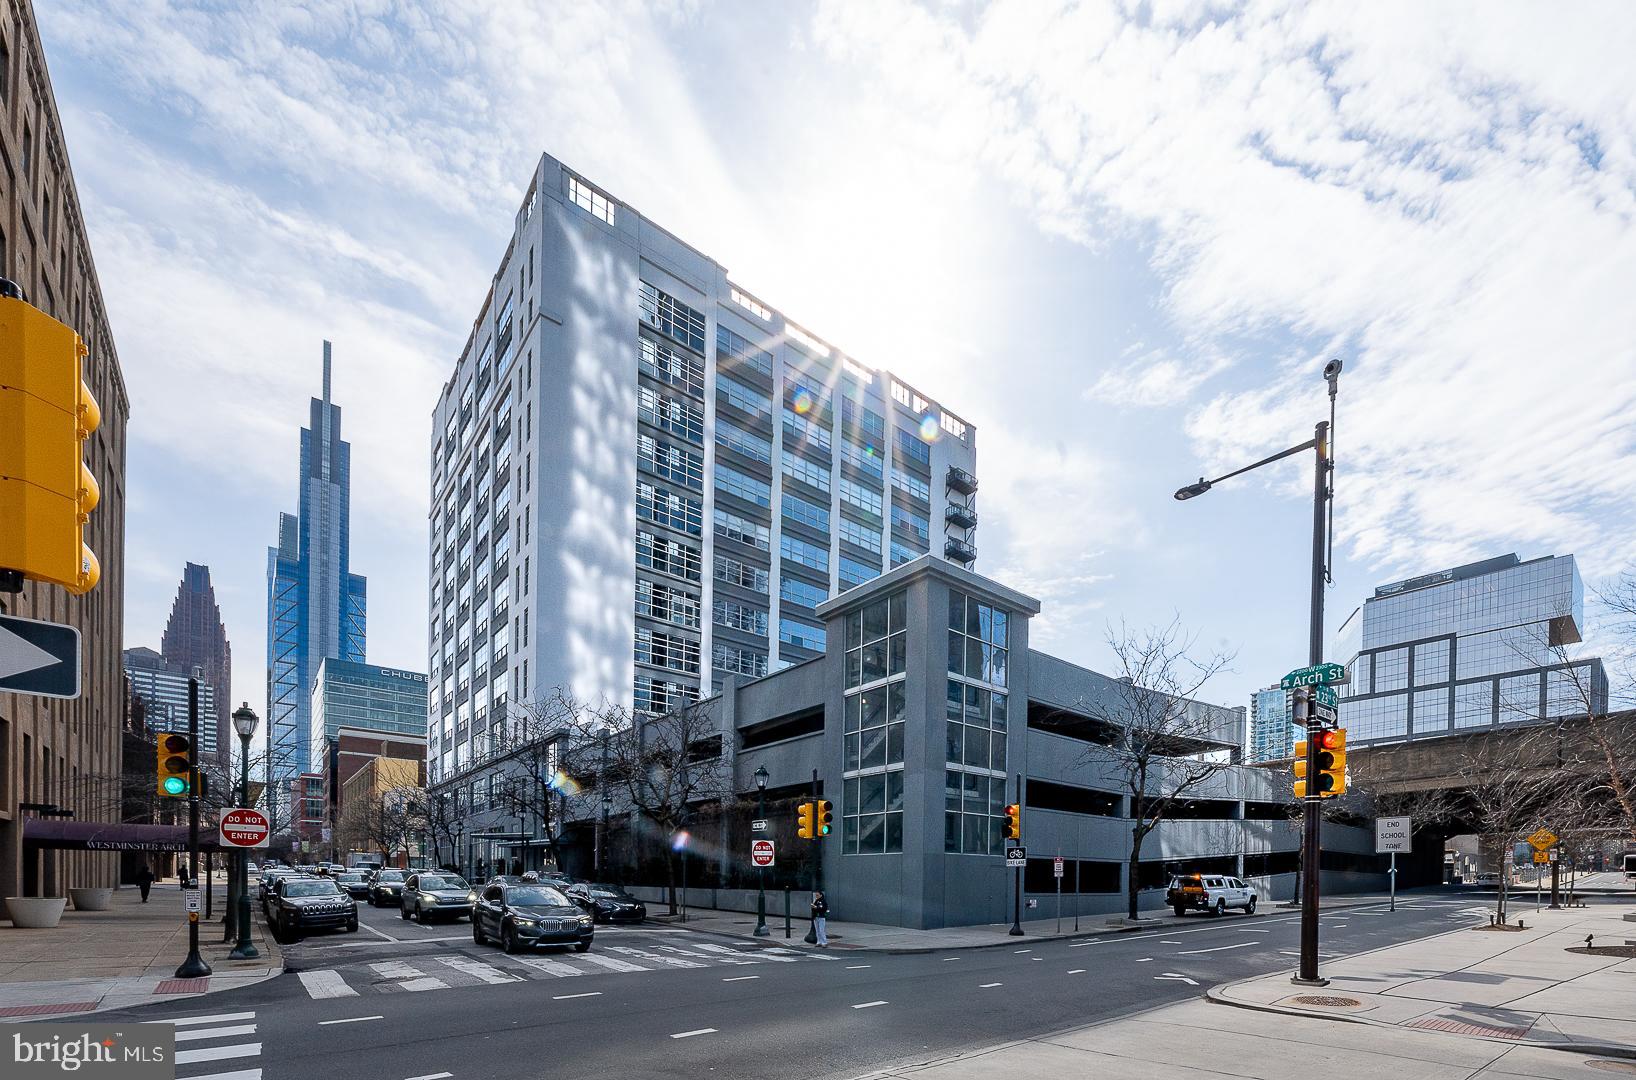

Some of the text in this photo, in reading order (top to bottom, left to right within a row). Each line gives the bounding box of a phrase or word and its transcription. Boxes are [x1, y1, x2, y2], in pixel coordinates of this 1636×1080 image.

[1293, 667, 1343, 687] Arch St
[228, 815, 262, 824] DO NOT
[231, 832, 259, 840] ENTER
[87, 841, 185, 851] WESTMINSTER ARCH
